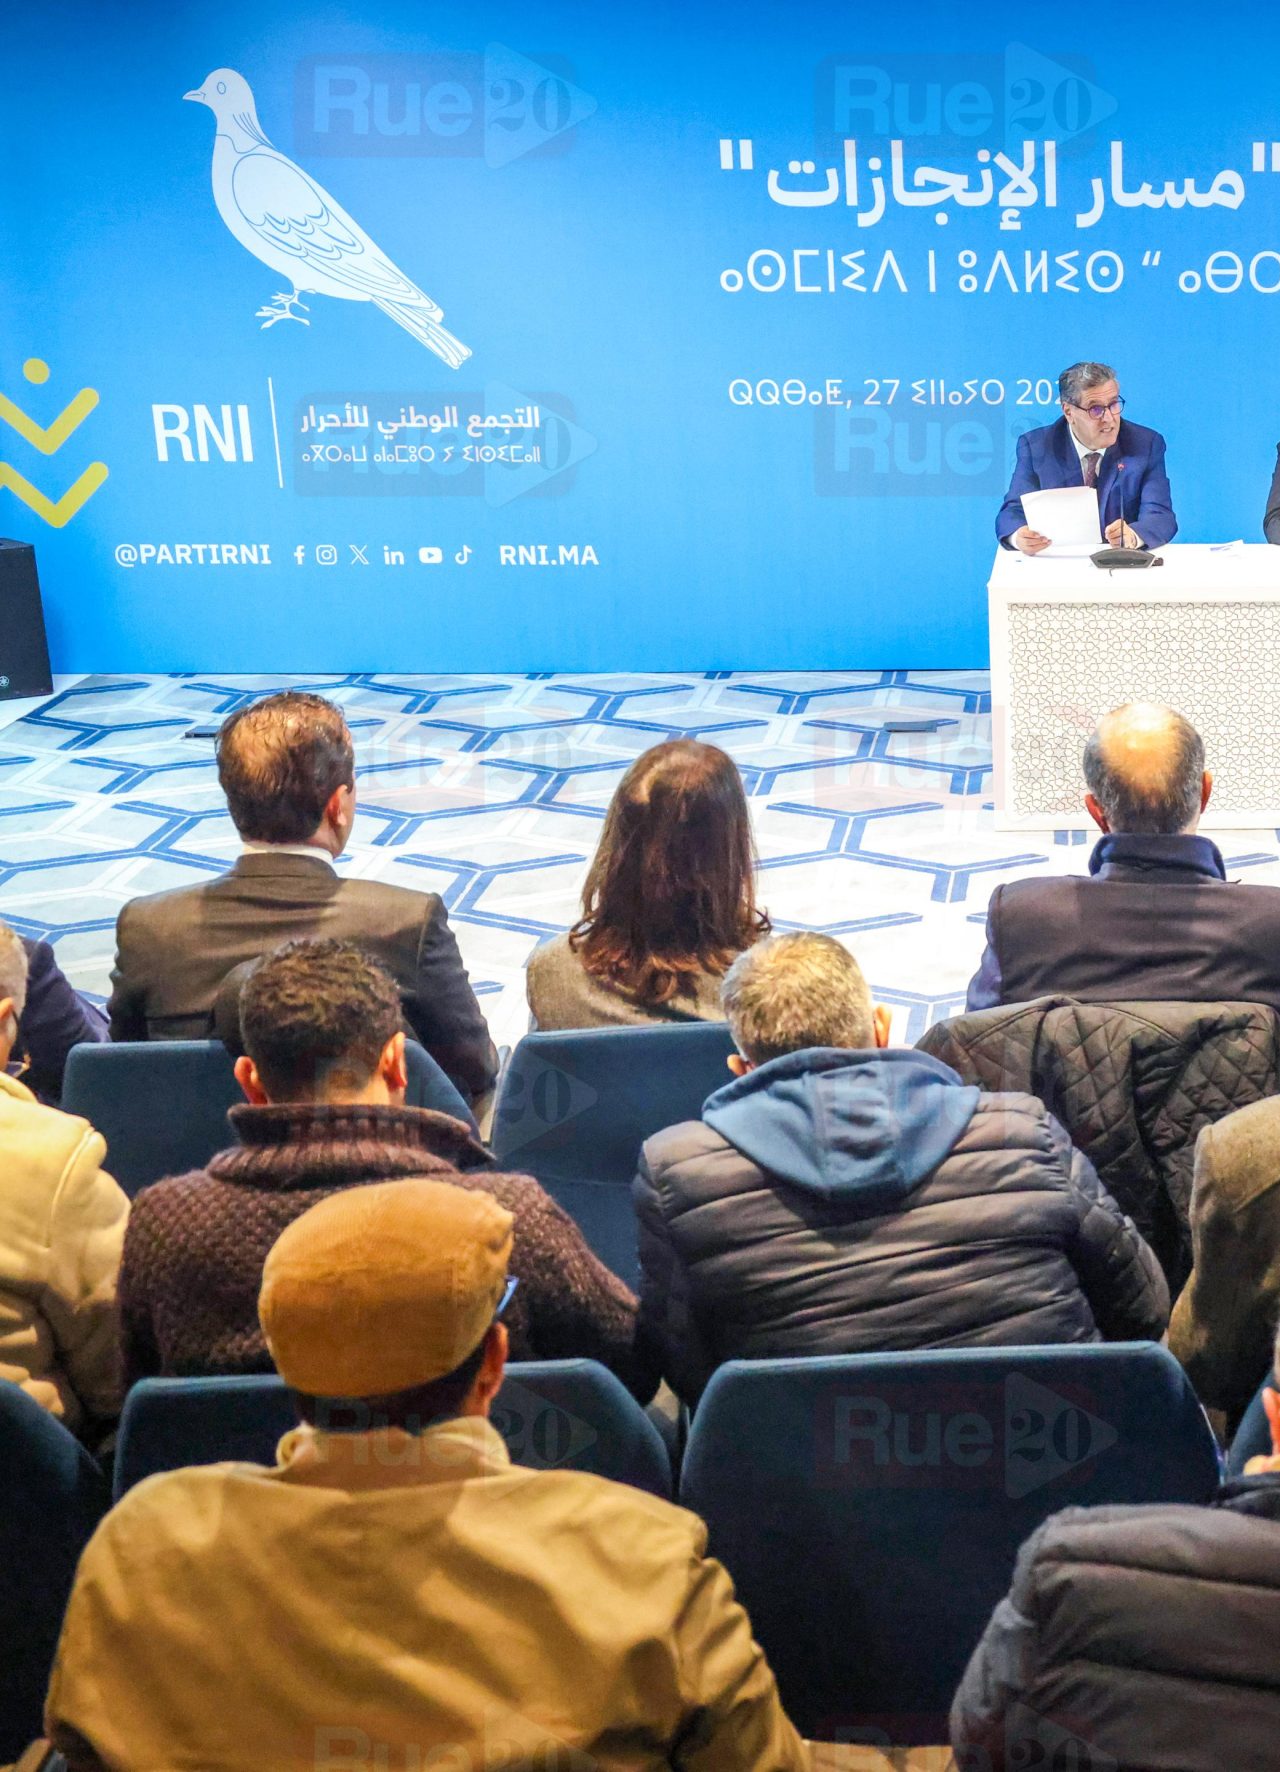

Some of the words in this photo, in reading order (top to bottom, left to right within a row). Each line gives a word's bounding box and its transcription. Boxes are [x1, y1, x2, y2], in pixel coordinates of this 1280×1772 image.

[863, 379, 900, 405] 27
[1016, 379, 1061, 405] 20
[151, 404, 254, 462] RNI
[301, 402, 369, 433] للأحرار
[377, 406, 458, 440] الوطني
[467, 406, 540, 438] التجمع
[115, 543, 272, 567] @PARTIRNI
[499, 544, 600, 565] RNI.MA
